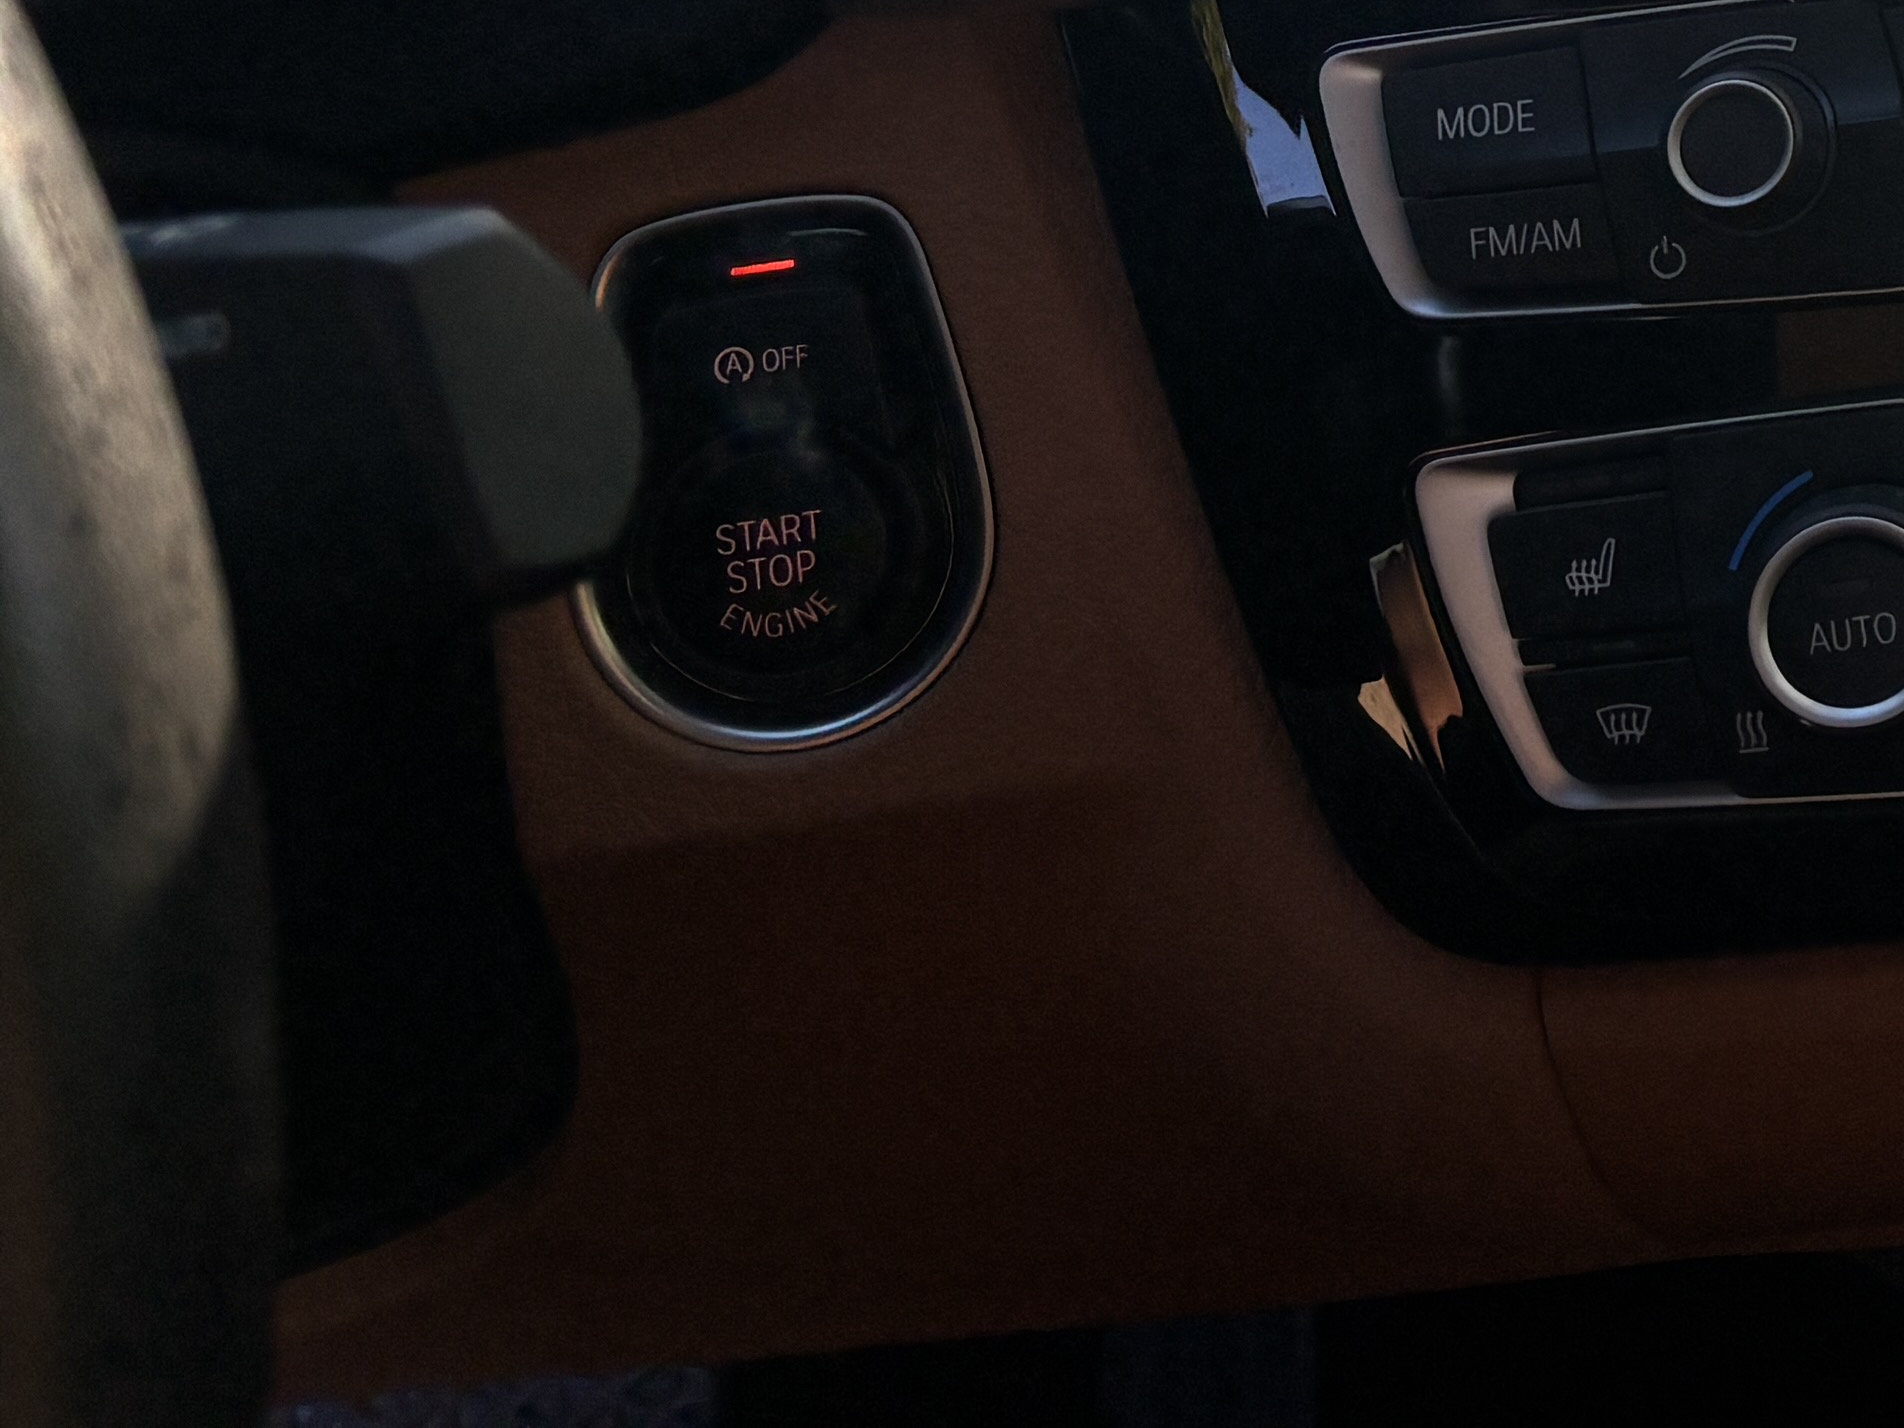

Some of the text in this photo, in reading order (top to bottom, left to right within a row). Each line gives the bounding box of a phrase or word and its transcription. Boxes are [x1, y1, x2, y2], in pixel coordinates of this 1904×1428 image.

[1437, 100, 1534, 140] MODE
[1470, 218, 1581, 259] FM/AM
[762, 345, 807, 371] OFF
[716, 510, 821, 555] START
[726, 549, 816, 594] STOP
[720, 590, 838, 638] ENGINE
[1810, 612, 1896, 654] AUTO
